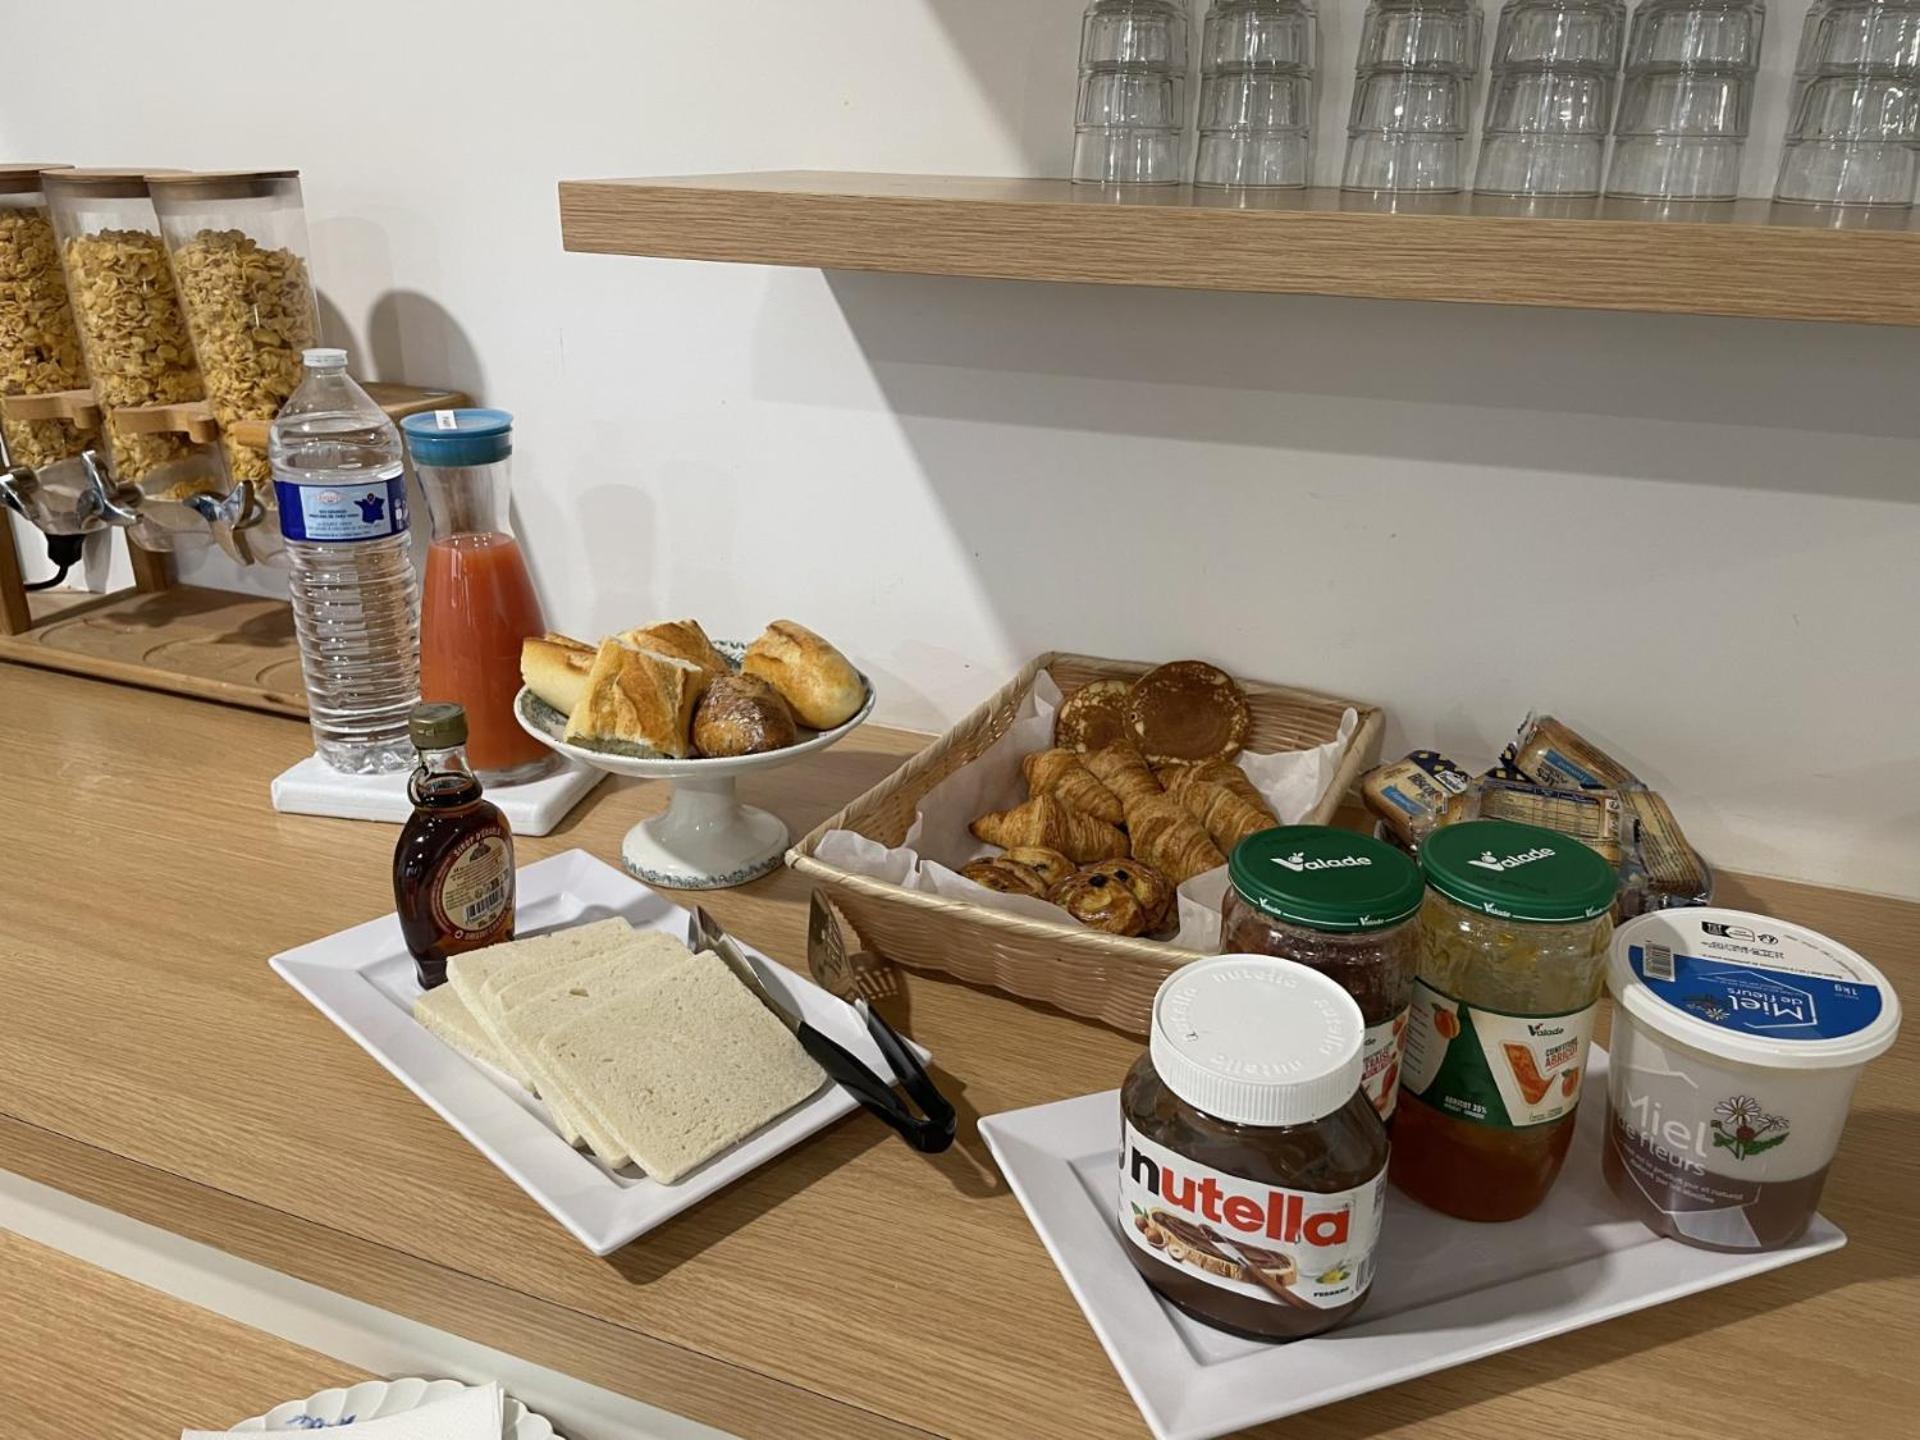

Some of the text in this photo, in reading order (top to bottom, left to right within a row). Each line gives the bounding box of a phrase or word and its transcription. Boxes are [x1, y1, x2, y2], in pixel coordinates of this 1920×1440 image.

[1269, 852, 1374, 873] Valade
[1467, 848, 1557, 872] Valade
[1211, 967, 1299, 989] nutella
[1727, 987, 1804, 1006] de fleurs
[1727, 994, 1804, 1021] Miel
[1528, 1023, 1565, 1036] Valade
[1545, 1045, 1578, 1068] ABRICOT
[1620, 1085, 1708, 1158] Miel
[1640, 1130, 1706, 1177] fleurs
[1130, 1146, 1350, 1248] nutella
